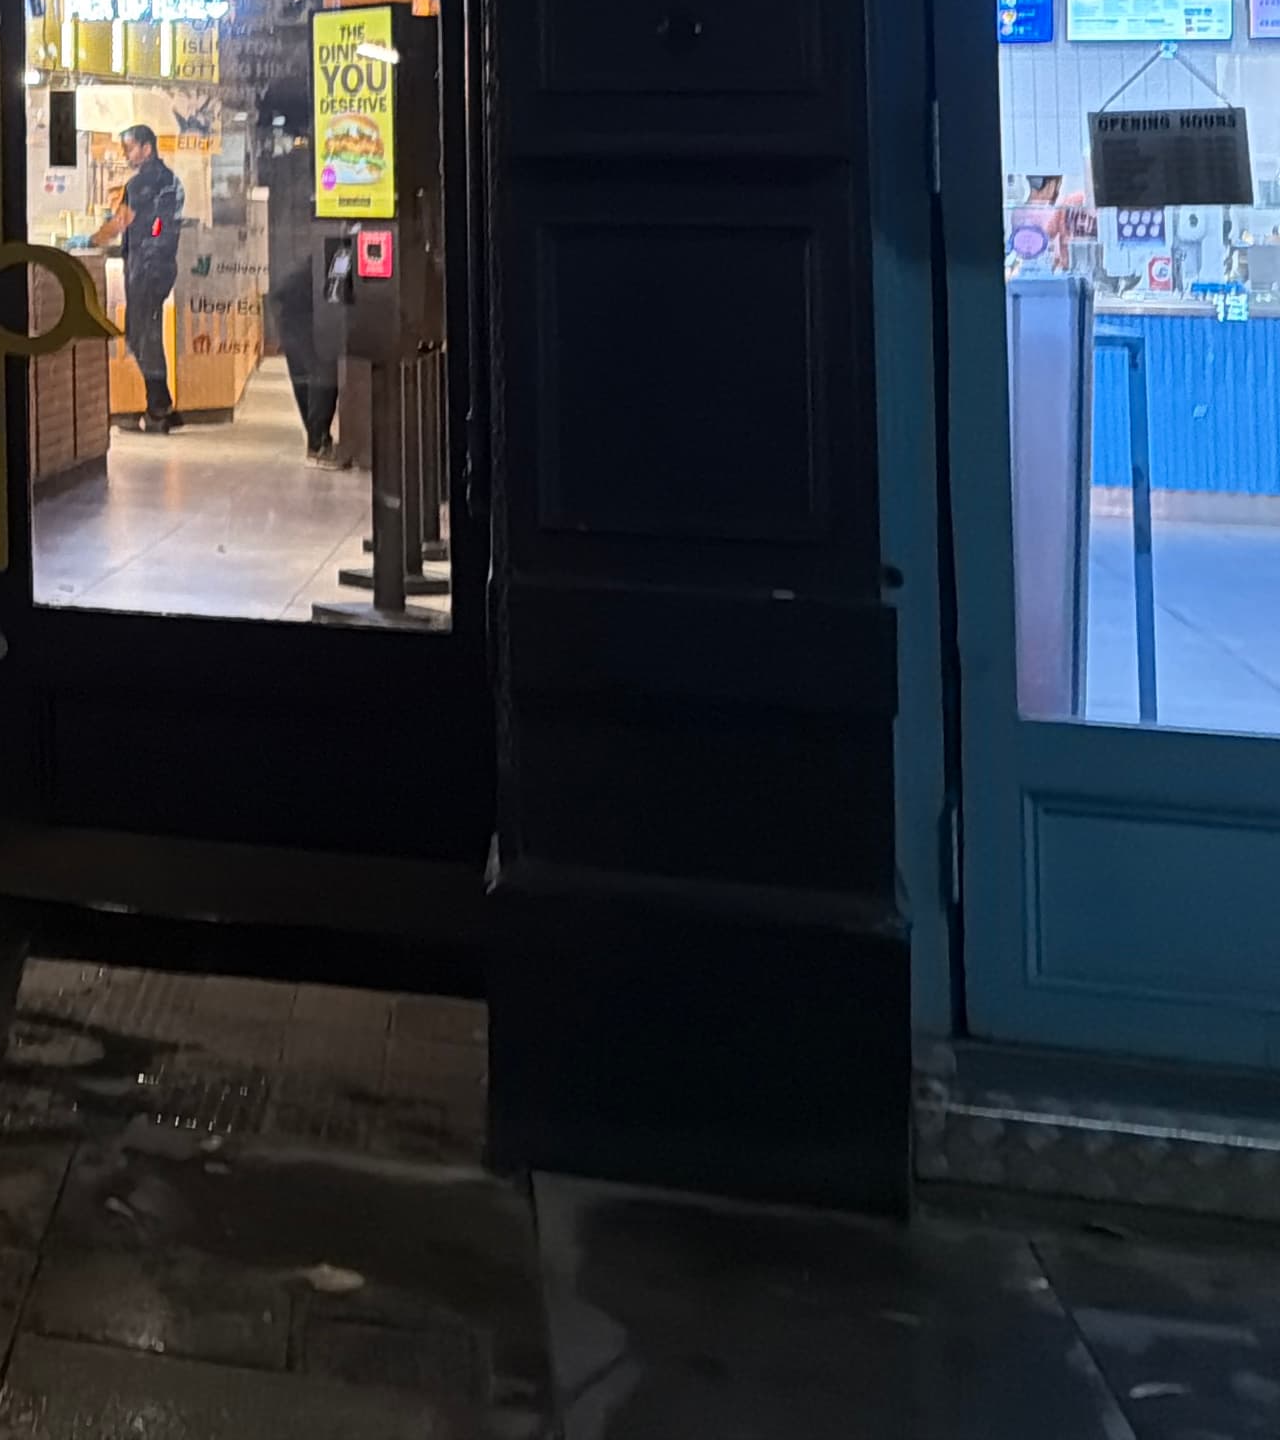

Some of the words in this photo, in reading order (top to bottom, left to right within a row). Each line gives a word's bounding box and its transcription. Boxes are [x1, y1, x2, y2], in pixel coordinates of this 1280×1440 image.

[339, 23, 365, 41] THE
[319, 40, 387, 65] DINN
[321, 62, 388, 96] YOU
[320, 96, 387, 115] DESERVE
[1097, 114, 1171, 132] OPENING
[1179, 112, 1237, 130] HOURS
[189, 296, 233, 314] Uber
